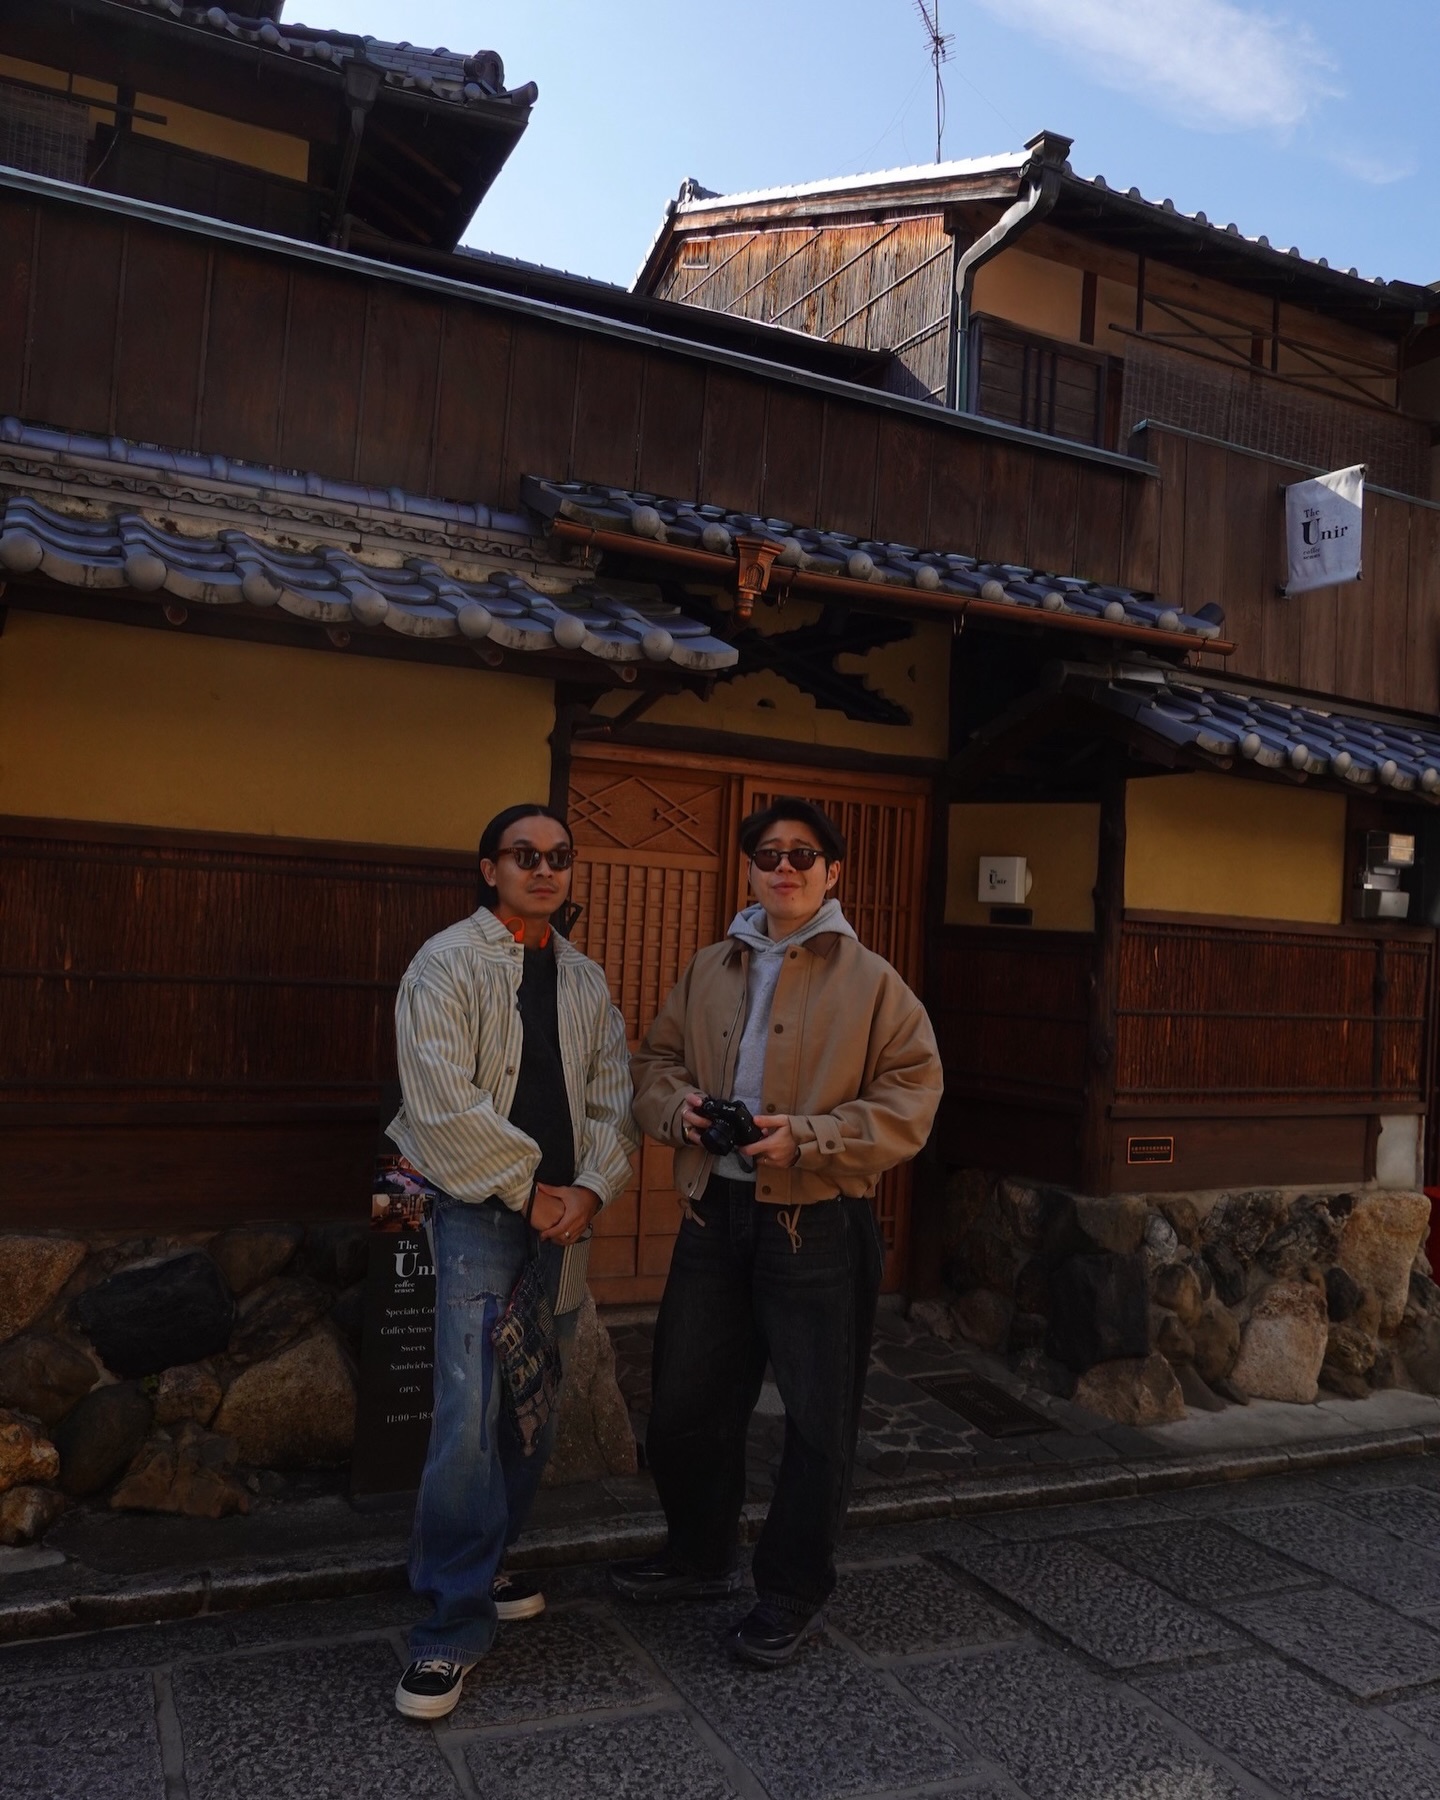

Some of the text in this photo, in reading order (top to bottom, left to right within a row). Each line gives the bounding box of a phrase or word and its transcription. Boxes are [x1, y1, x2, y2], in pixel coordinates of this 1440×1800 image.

[1303, 508, 1320, 518] The
[1301, 518, 1348, 545] Unir
[397, 1240, 419, 1251] The
[394, 1279, 416, 1288] coffee
[385, 1307, 420, 1318] Specialty
[380, 1324, 433, 1336] Coffee Senses
[400, 1344, 426, 1353] Sweets
[390, 1361, 434, 1371] Sandwiches
[399, 1385, 421, 1394] OPEN
